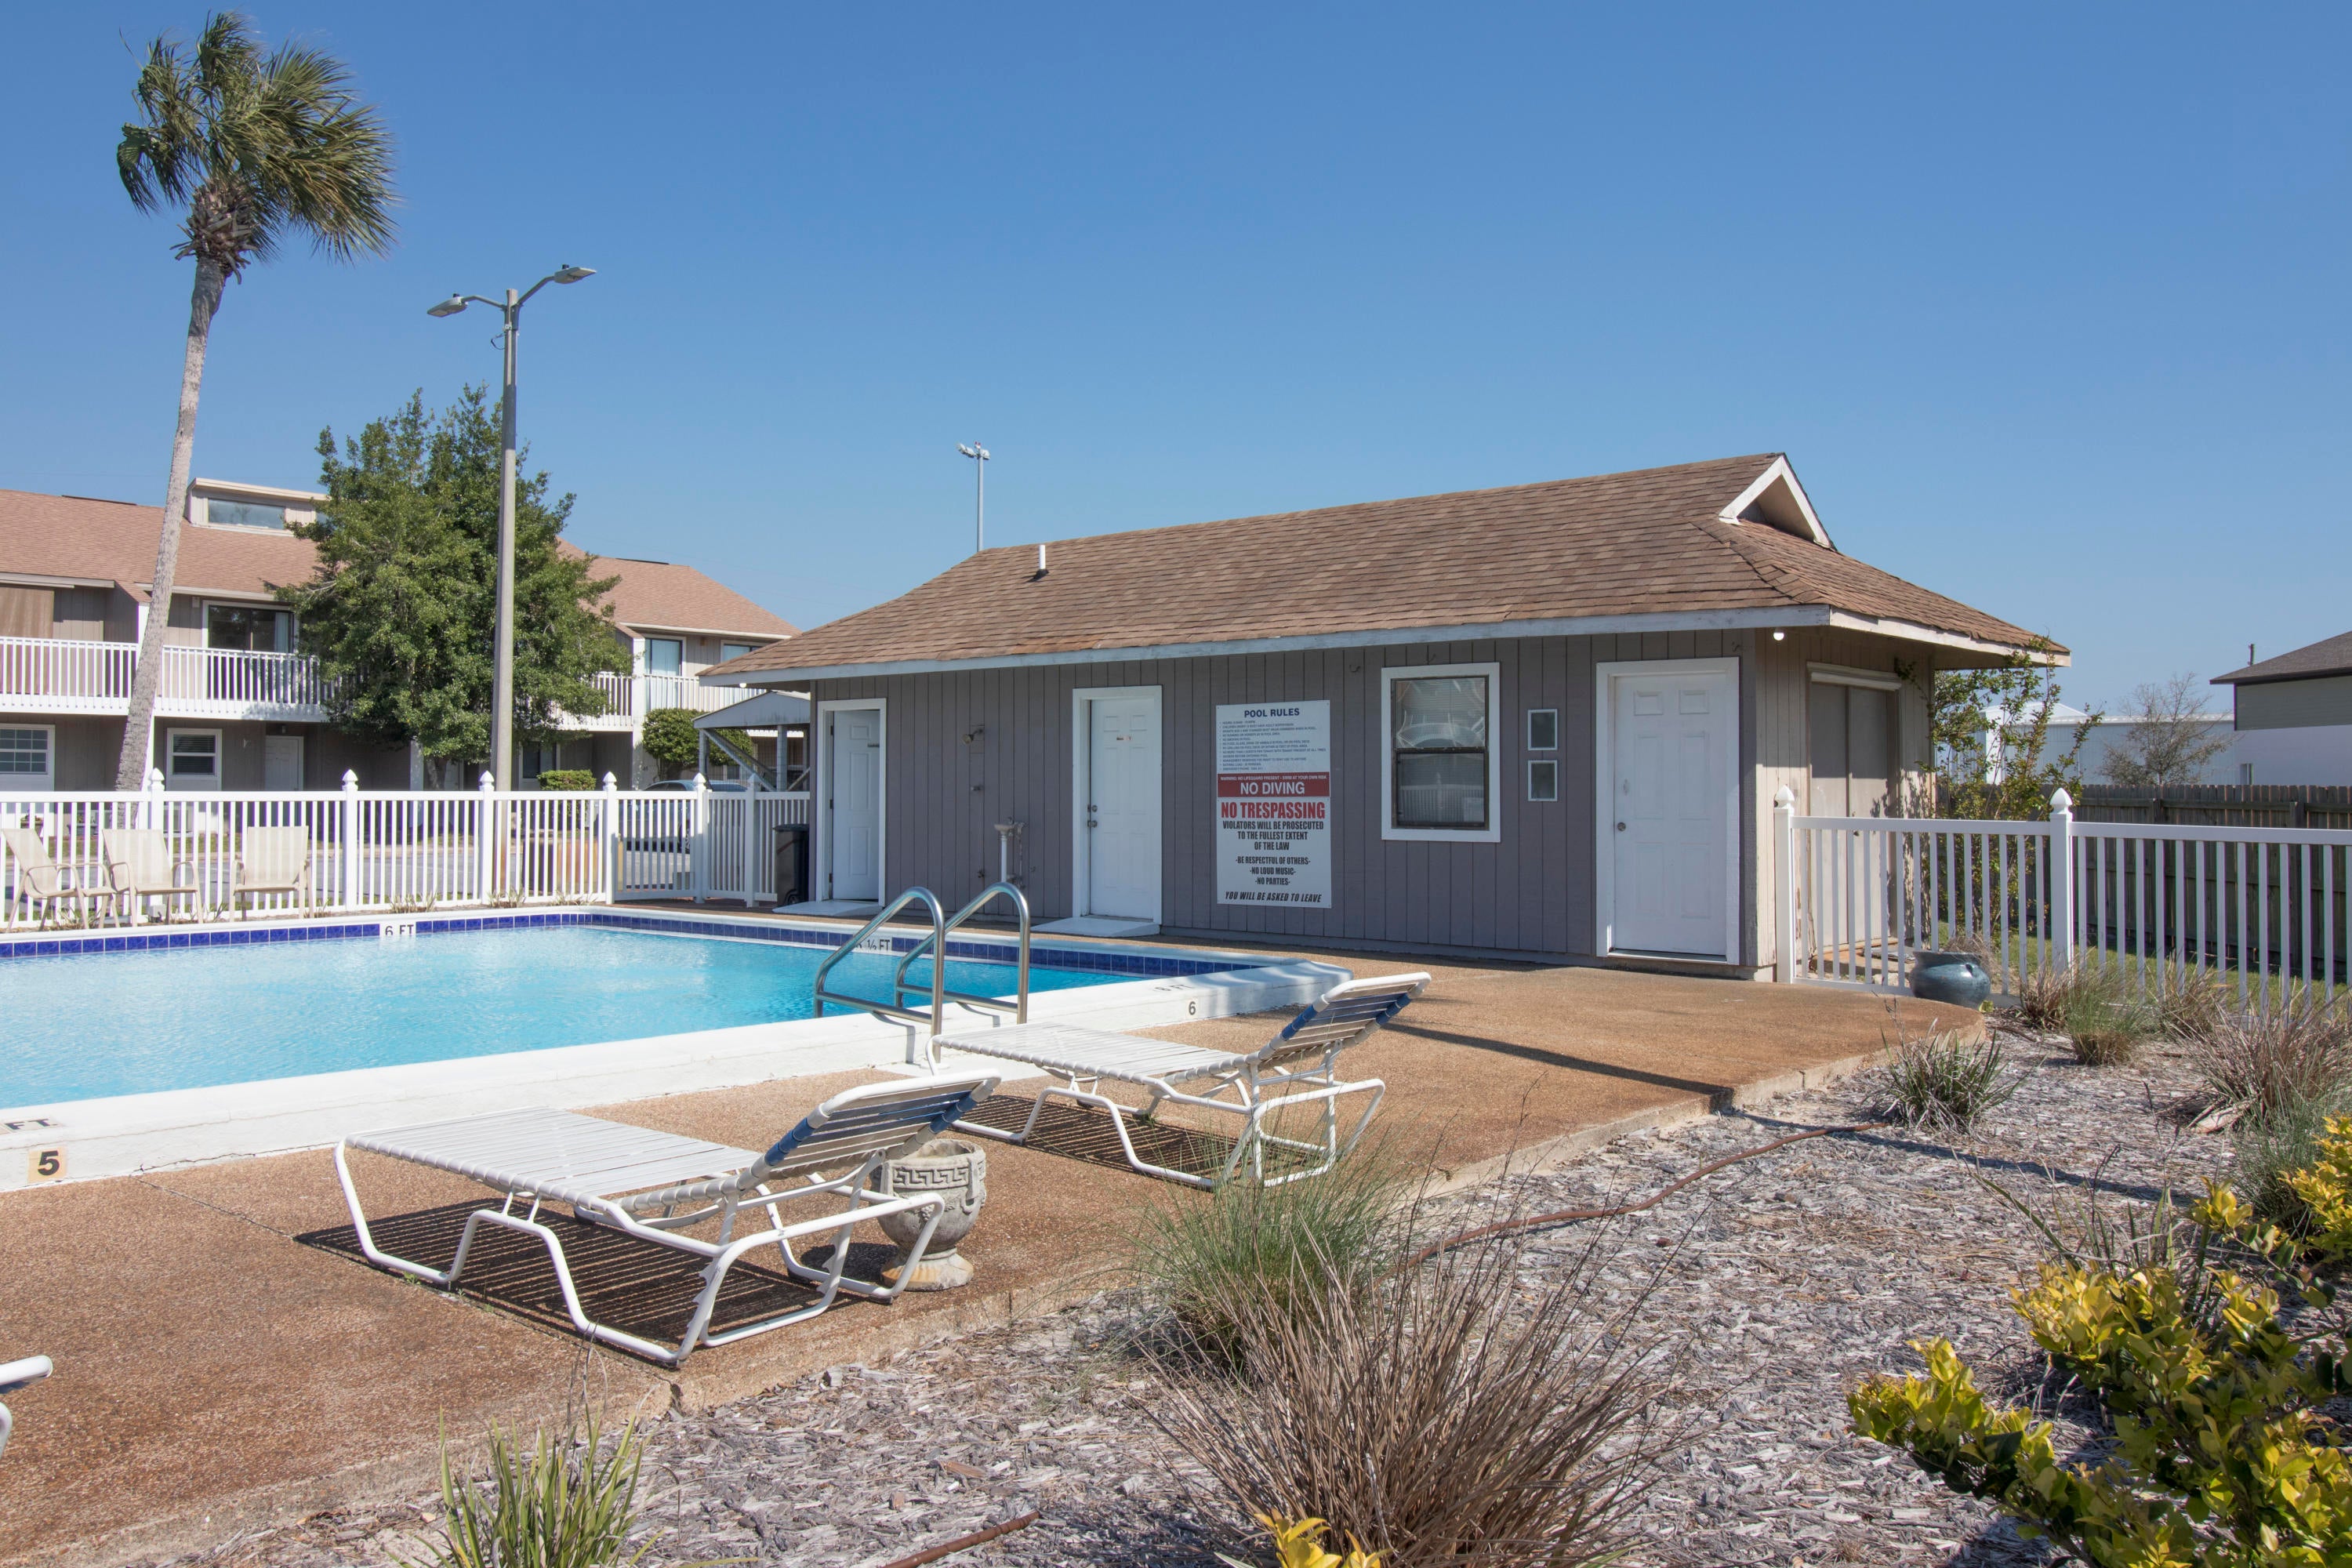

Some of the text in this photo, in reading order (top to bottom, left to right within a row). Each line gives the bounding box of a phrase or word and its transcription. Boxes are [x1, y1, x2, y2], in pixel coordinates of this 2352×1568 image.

[1244, 708, 1300, 718] POOL RULES
[1240, 782, 1305, 794] NO DIVING
[1221, 801, 1325, 818] NO TRESPASSING
[1223, 821, 1323, 829] VIOLATORS WILL BE PROSECUTED
[1238, 831, 1308, 840] TO THE FULLEST EXTENT
[1254, 841, 1289, 850] OF THE LAW
[1225, 891, 1322, 902] YOU WILL BE ASKED TO LEAVE
[385, 924, 414, 936] 6 FT
[880, 939, 891, 951] FT
[1189, 1001, 1196, 1015] 6
[38, 1149, 60, 1176] 5
